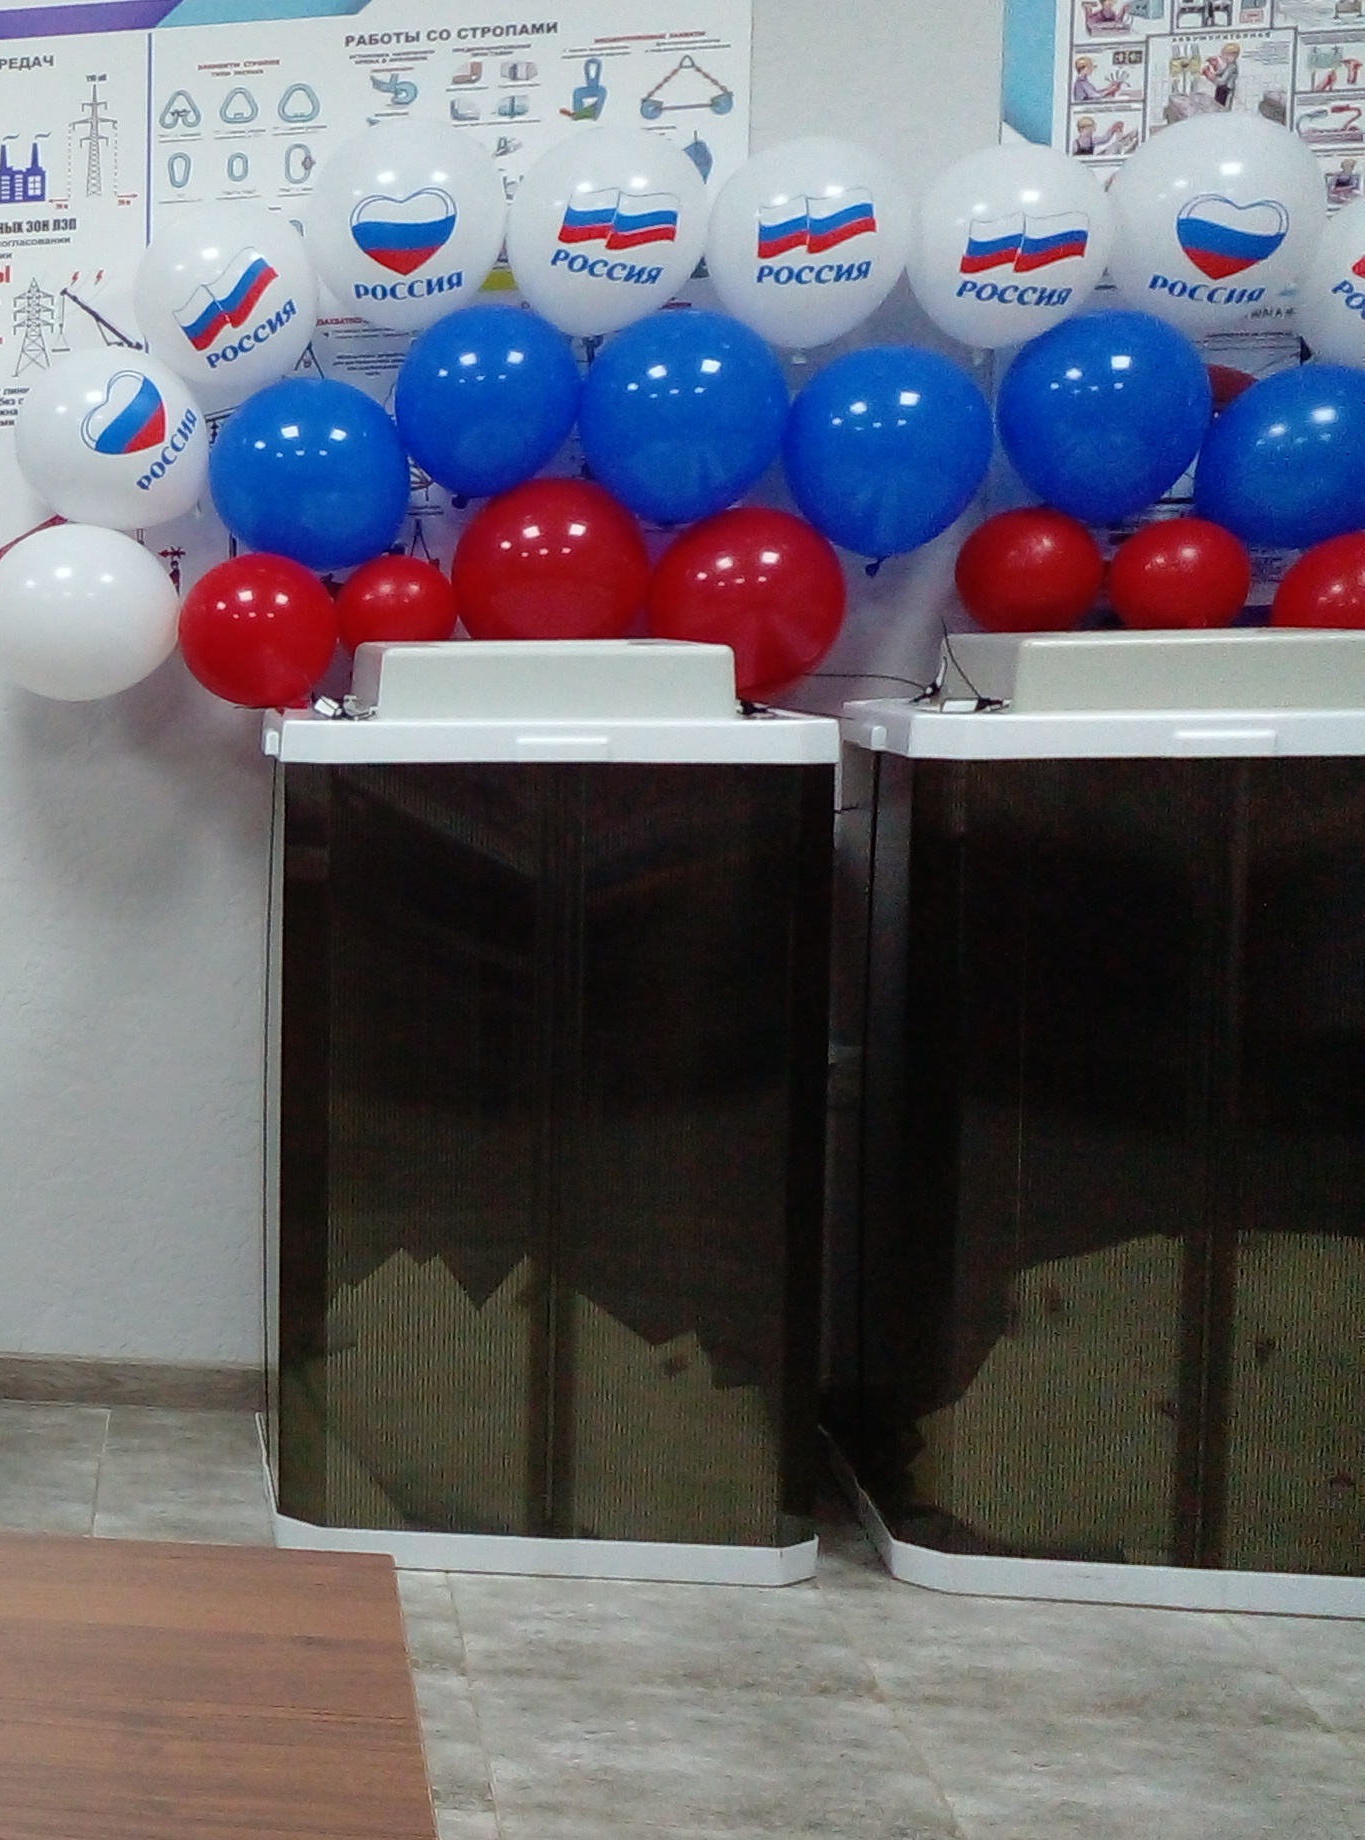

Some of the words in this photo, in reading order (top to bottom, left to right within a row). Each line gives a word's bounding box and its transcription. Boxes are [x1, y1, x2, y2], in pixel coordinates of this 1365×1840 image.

[344, 30, 420, 48] РАБОТЫ
[426, 28, 451, 42] СО
[457, 21, 559, 41] СТРОПАМИ
[26, 219, 50, 232] ЗОН
[52, 218, 77, 231] ЛЭП
[549, 248, 664, 285] РОССИЯ
[755, 259, 873, 285] РОССИЯ
[353, 270, 464, 301] РОССИЯ
[955, 279, 1073, 307] РОССИЯ
[1148, 273, 1267, 304] РОССИЯ
[205, 299, 299, 369] РОССИЯ
[136, 407, 198, 492] РОССИЯ
